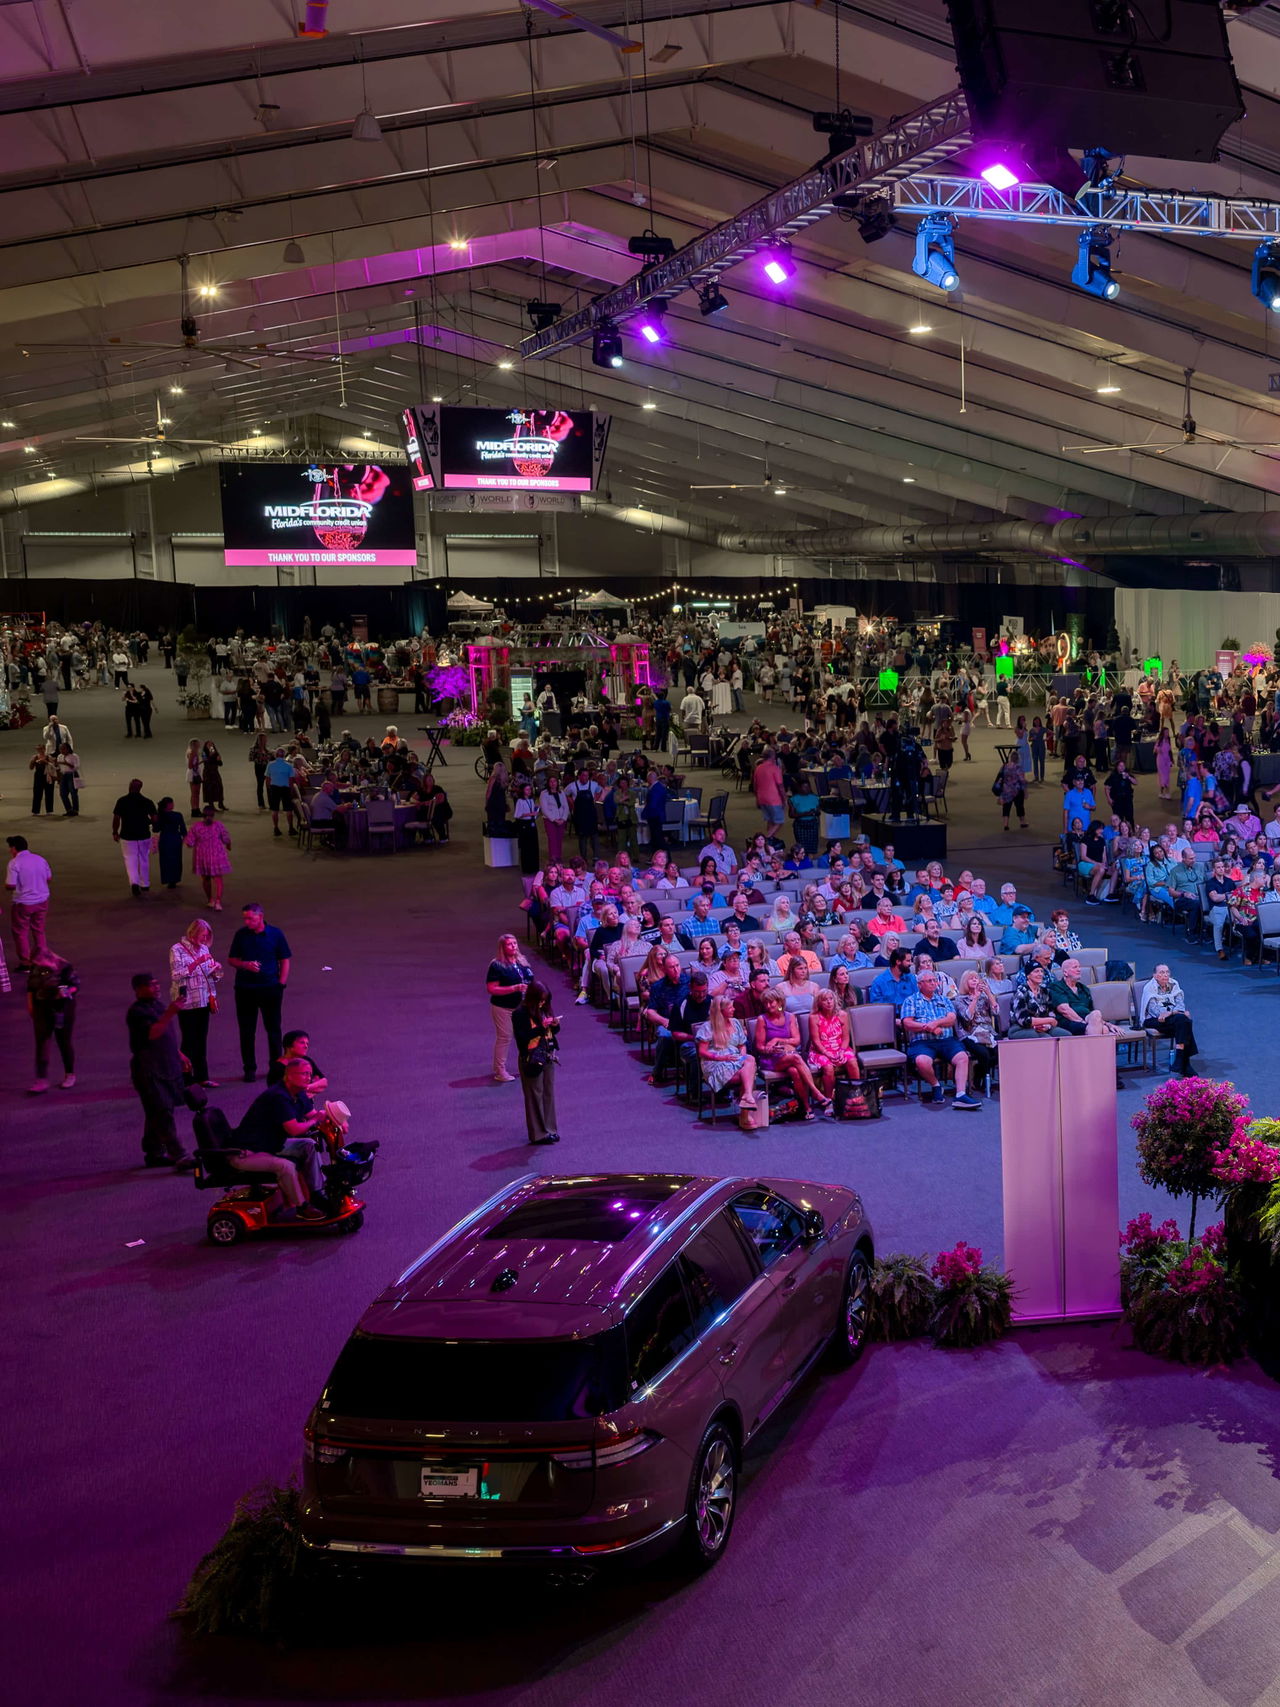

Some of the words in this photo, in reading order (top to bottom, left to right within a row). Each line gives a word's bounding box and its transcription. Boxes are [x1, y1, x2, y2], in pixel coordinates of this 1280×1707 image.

[476, 440, 560, 453] MIDFLORIDA
[477, 477, 497, 486] THANK
[497, 478, 509, 486] YOU
[509, 479, 517, 487] TO
[517, 479, 529, 487] OUR
[530, 479, 559, 488] SPONSORS
[480, 495, 513, 504] WORLD
[264, 504, 372, 518] MIDFLORIDA
[271, 518, 303, 529] Florida's
[303, 519, 334, 527] community
[334, 518, 350, 526] credit
[350, 519, 367, 527] union
[267, 553, 293, 562] THANK
[294, 553, 309, 562] YOU
[310, 553, 320, 562] TO
[321, 553, 337, 562] OUR
[337, 553, 376, 562] SPONSORS
